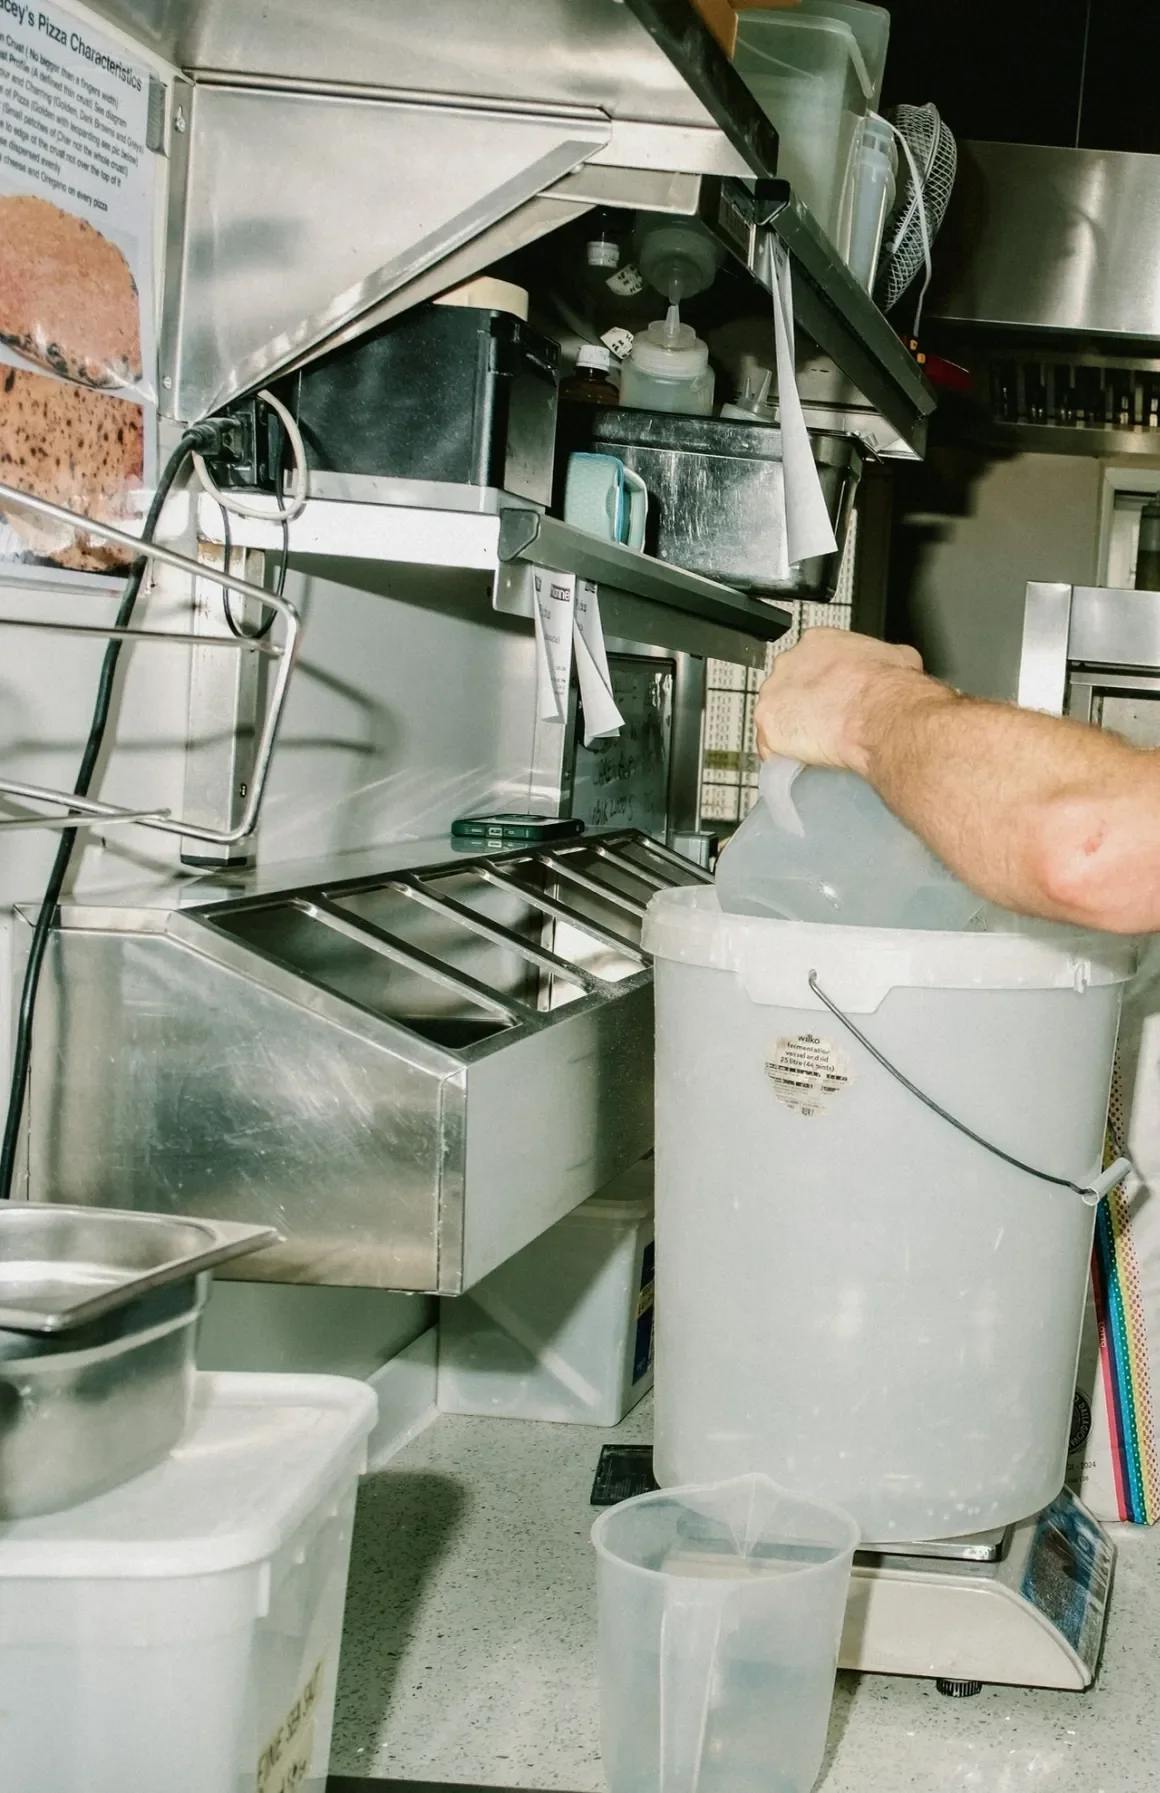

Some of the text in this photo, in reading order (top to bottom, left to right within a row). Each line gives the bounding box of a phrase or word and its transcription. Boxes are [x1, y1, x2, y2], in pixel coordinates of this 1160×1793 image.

[6, 34, 25, 54] Crust
[61, 66, 75, 82] than
[38, 12, 68, 46] Pizza
[70, 33, 142, 92] Characteristics
[9, 53, 30, 73] Profile
[39, 71, 62, 92] defined
[63, 84, 75, 98] thin
[94, 101, 105, 115] See
[105, 109, 127, 129] diagram
[12, 75, 25, 88] and
[25, 80, 52, 106] Charring
[80, 110, 93, 124] Dark
[116, 131, 127, 145] and
[5, 87, 12, 98] of
[13, 90, 30, 108] Pizza
[56, 113, 70, 128] with
[70, 120, 100, 149] leoparding
[24, 115, 49, 135] patches
[49, 127, 57, 139] of
[72, 141, 83, 153] not
[83, 144, 92, 157] the
[93, 151, 110, 167] whole
[9, 139, 41, 164] dispersed
[41, 157, 62, 177] evenly
[14, 127, 30, 143] edge
[30, 134, 38, 145] of
[38, 137, 49, 151] the
[49, 144, 65, 160] crust
[66, 153, 76, 165] not
[77, 159, 90, 172] over
[90, 163, 100, 178] the
[100, 170, 111, 185] top
[4, 155, 109, 213] cheese and Oregano on every pizza
[780, 1056, 788, 1064] 25
[789, 1057, 802, 1067] litre
[785, 1051, 806, 1059] vessel
[807, 1052, 819, 1061] and
[787, 1041, 830, 1055] fermentation
[798, 1034, 820, 1044] wilko
[1080, 1460, 1097, 1470] 2024
